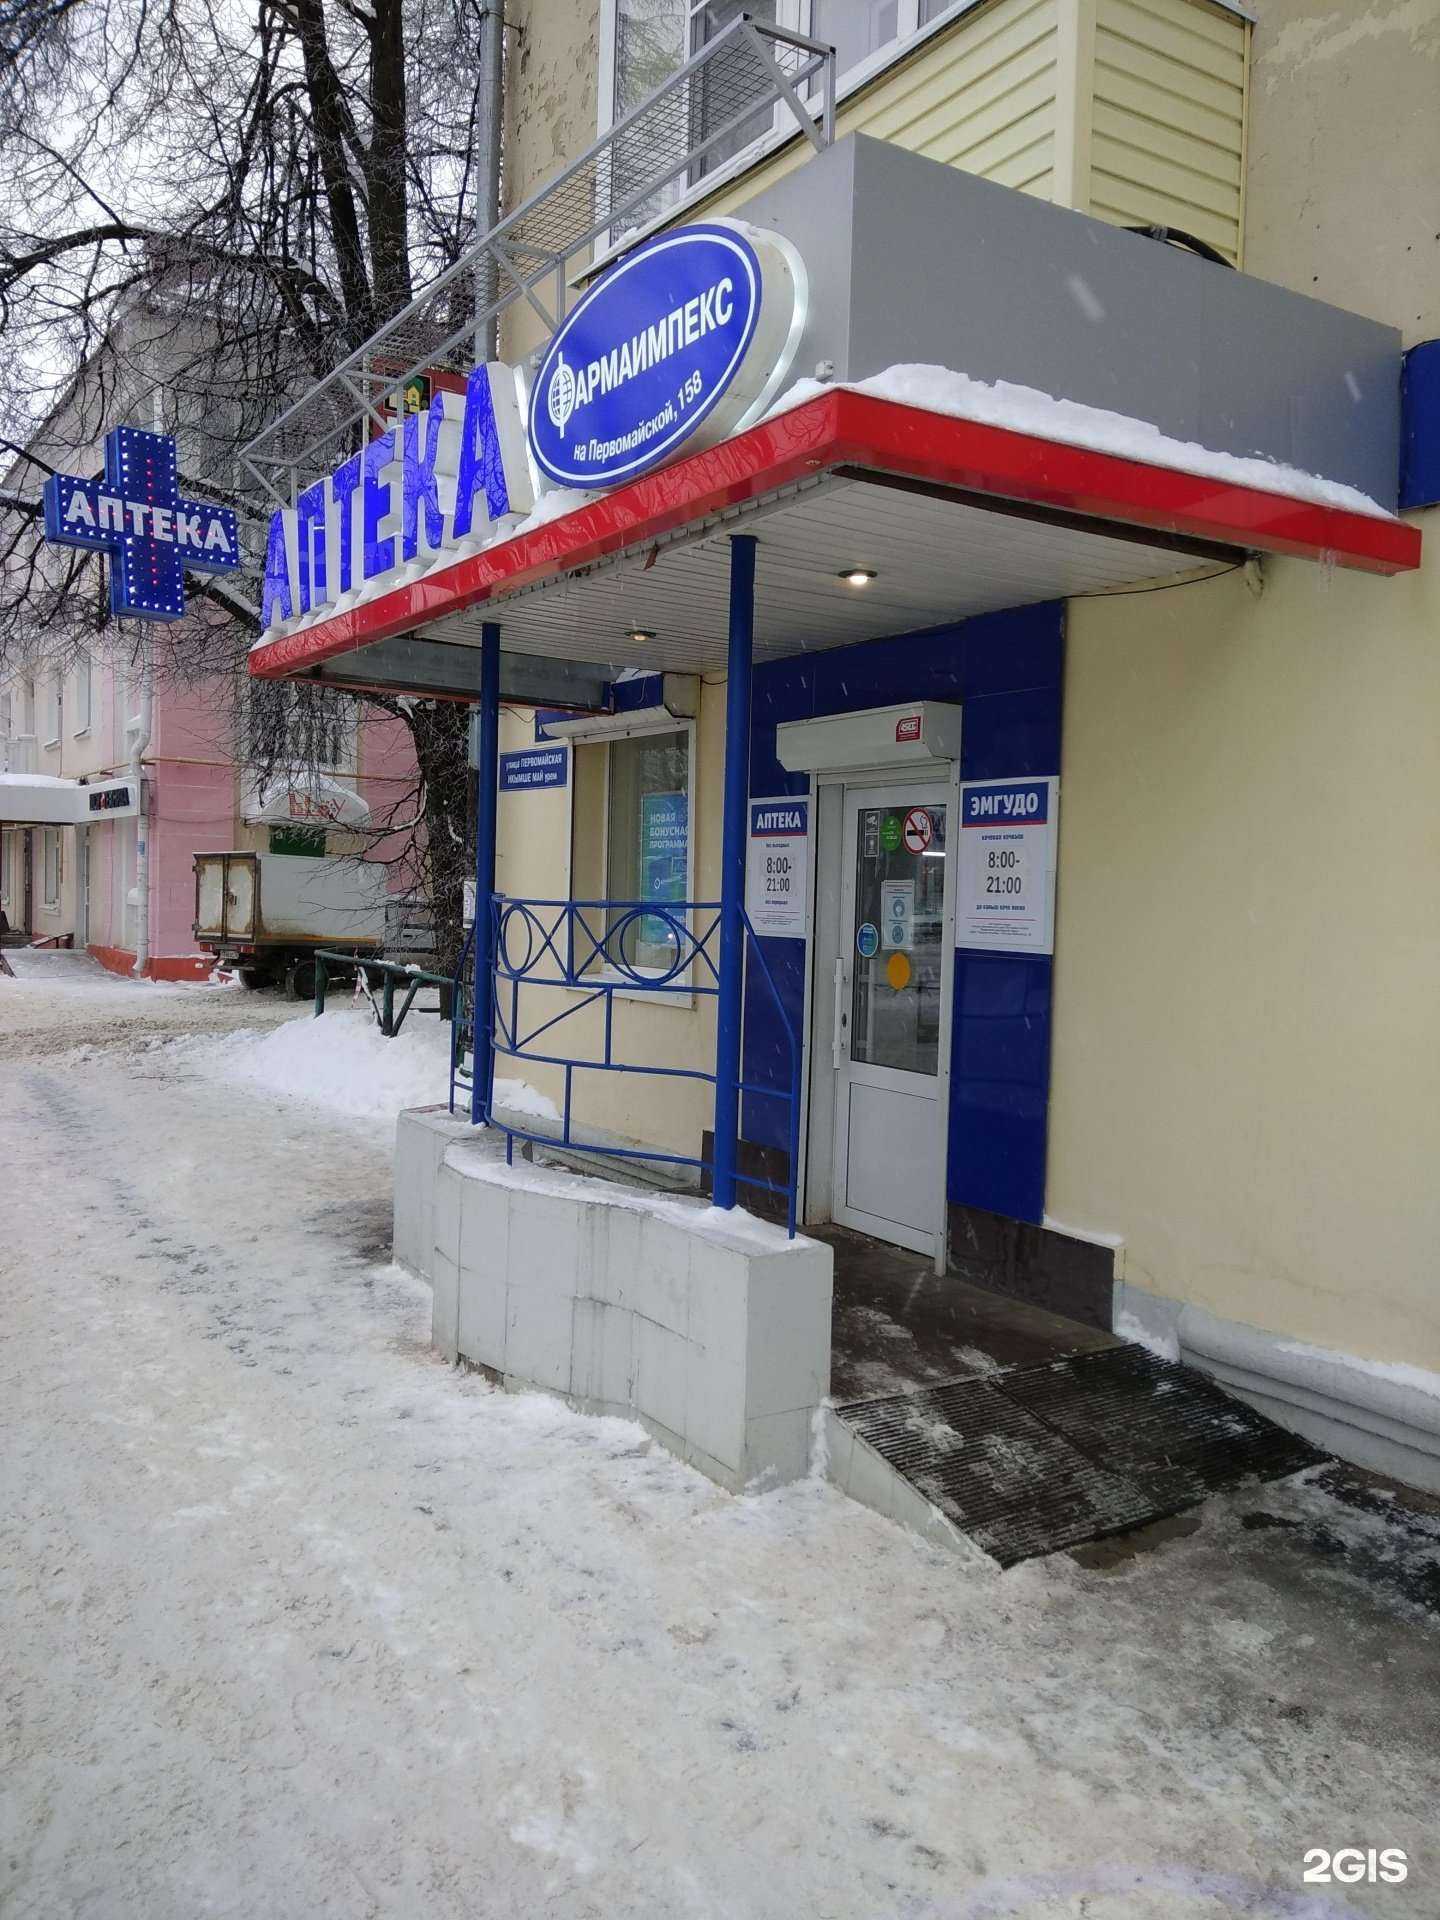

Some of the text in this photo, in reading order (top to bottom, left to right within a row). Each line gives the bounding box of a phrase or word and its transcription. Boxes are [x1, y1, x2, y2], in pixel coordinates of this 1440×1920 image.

[548, 277, 734, 439] ФАРМАИМПЕКС
[573, 369, 703, 465] на Первомайской, 158
[261, 361, 511, 633] АПТЕКА
[65, 490, 231, 553] АПТЕКА
[520, 753, 562, 768] ПЕРВОМАЙСКАЯ
[532, 769, 544, 782] МАЙ
[970, 792, 1039, 817] ЭМГУДО
[650, 813, 676, 825] НОВАЯ
[756, 811, 802, 829] АПТЕКА
[766, 857, 792, 875] 8:00-
[987, 850, 1021, 869] 8:00-
[766, 877, 790, 893] 21:00
[986, 876, 1022, 894] 21:00
